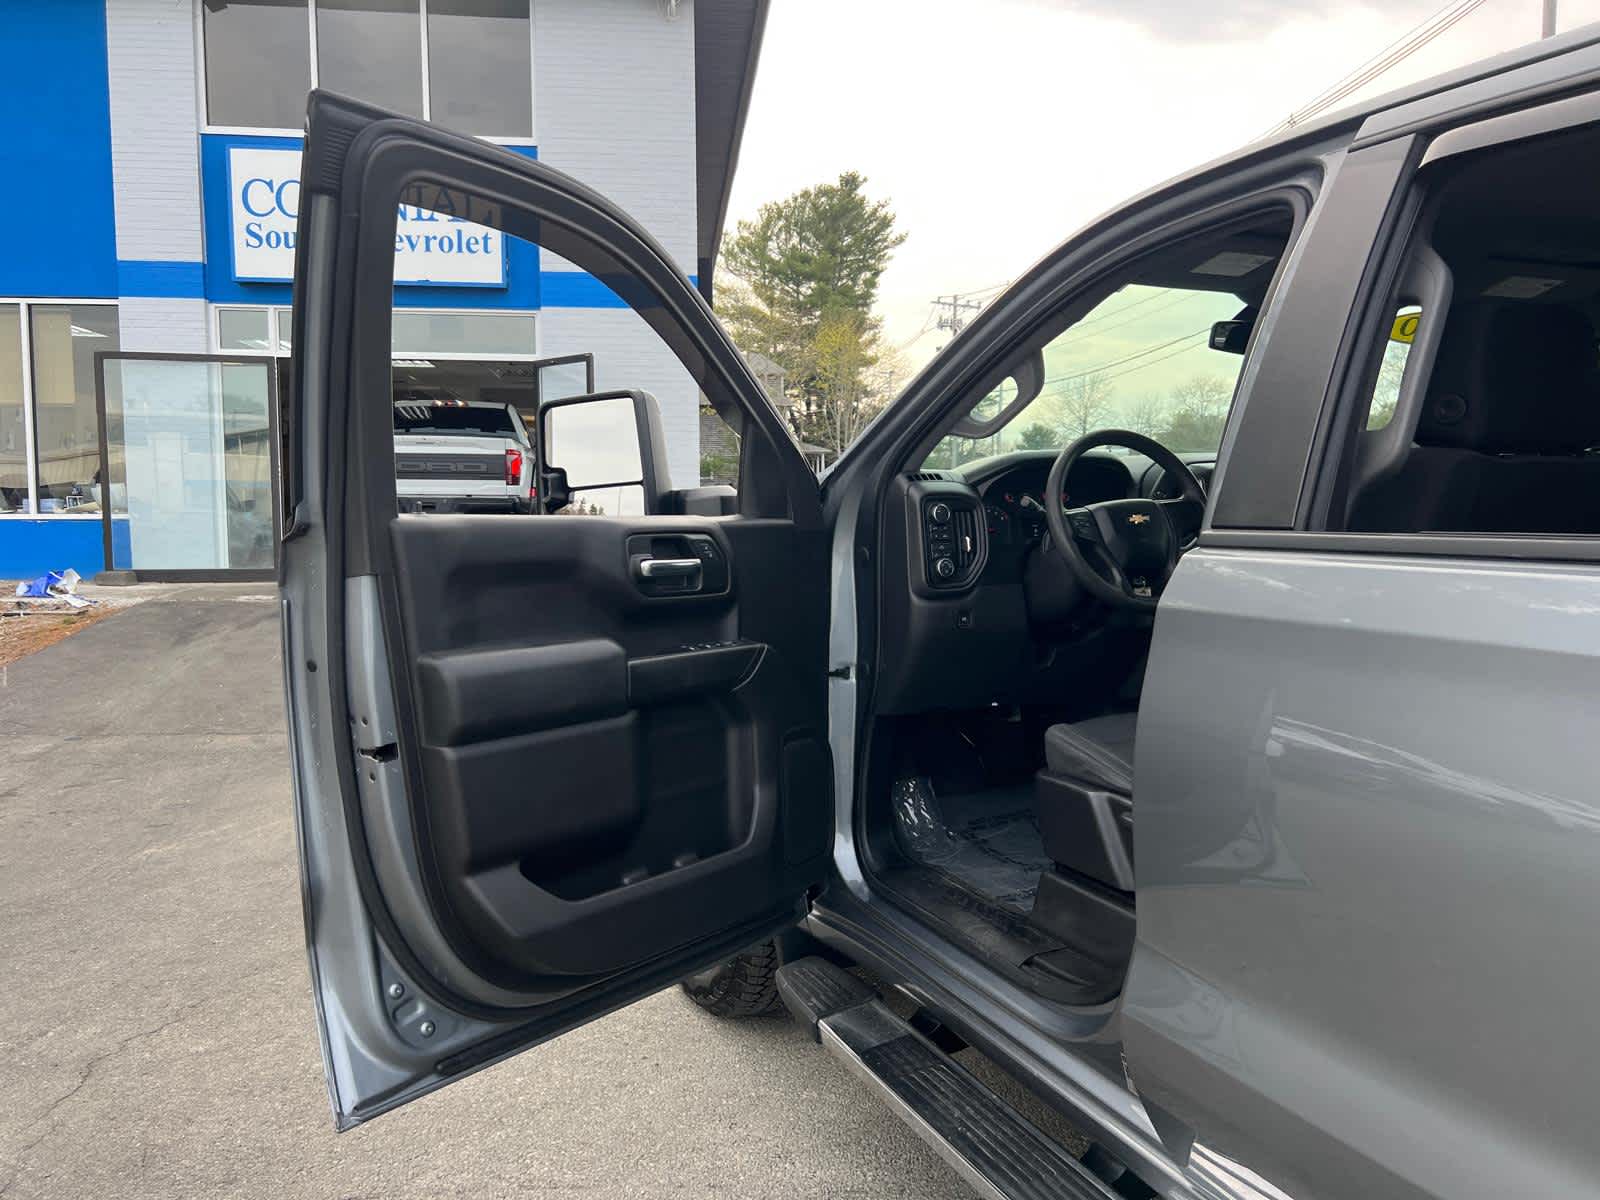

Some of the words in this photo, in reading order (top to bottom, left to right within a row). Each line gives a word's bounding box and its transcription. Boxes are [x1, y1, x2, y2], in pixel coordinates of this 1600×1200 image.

[245, 222, 297, 249] Sou
[395, 229, 492, 254] evrolet
[397, 462, 488, 472] ORD
